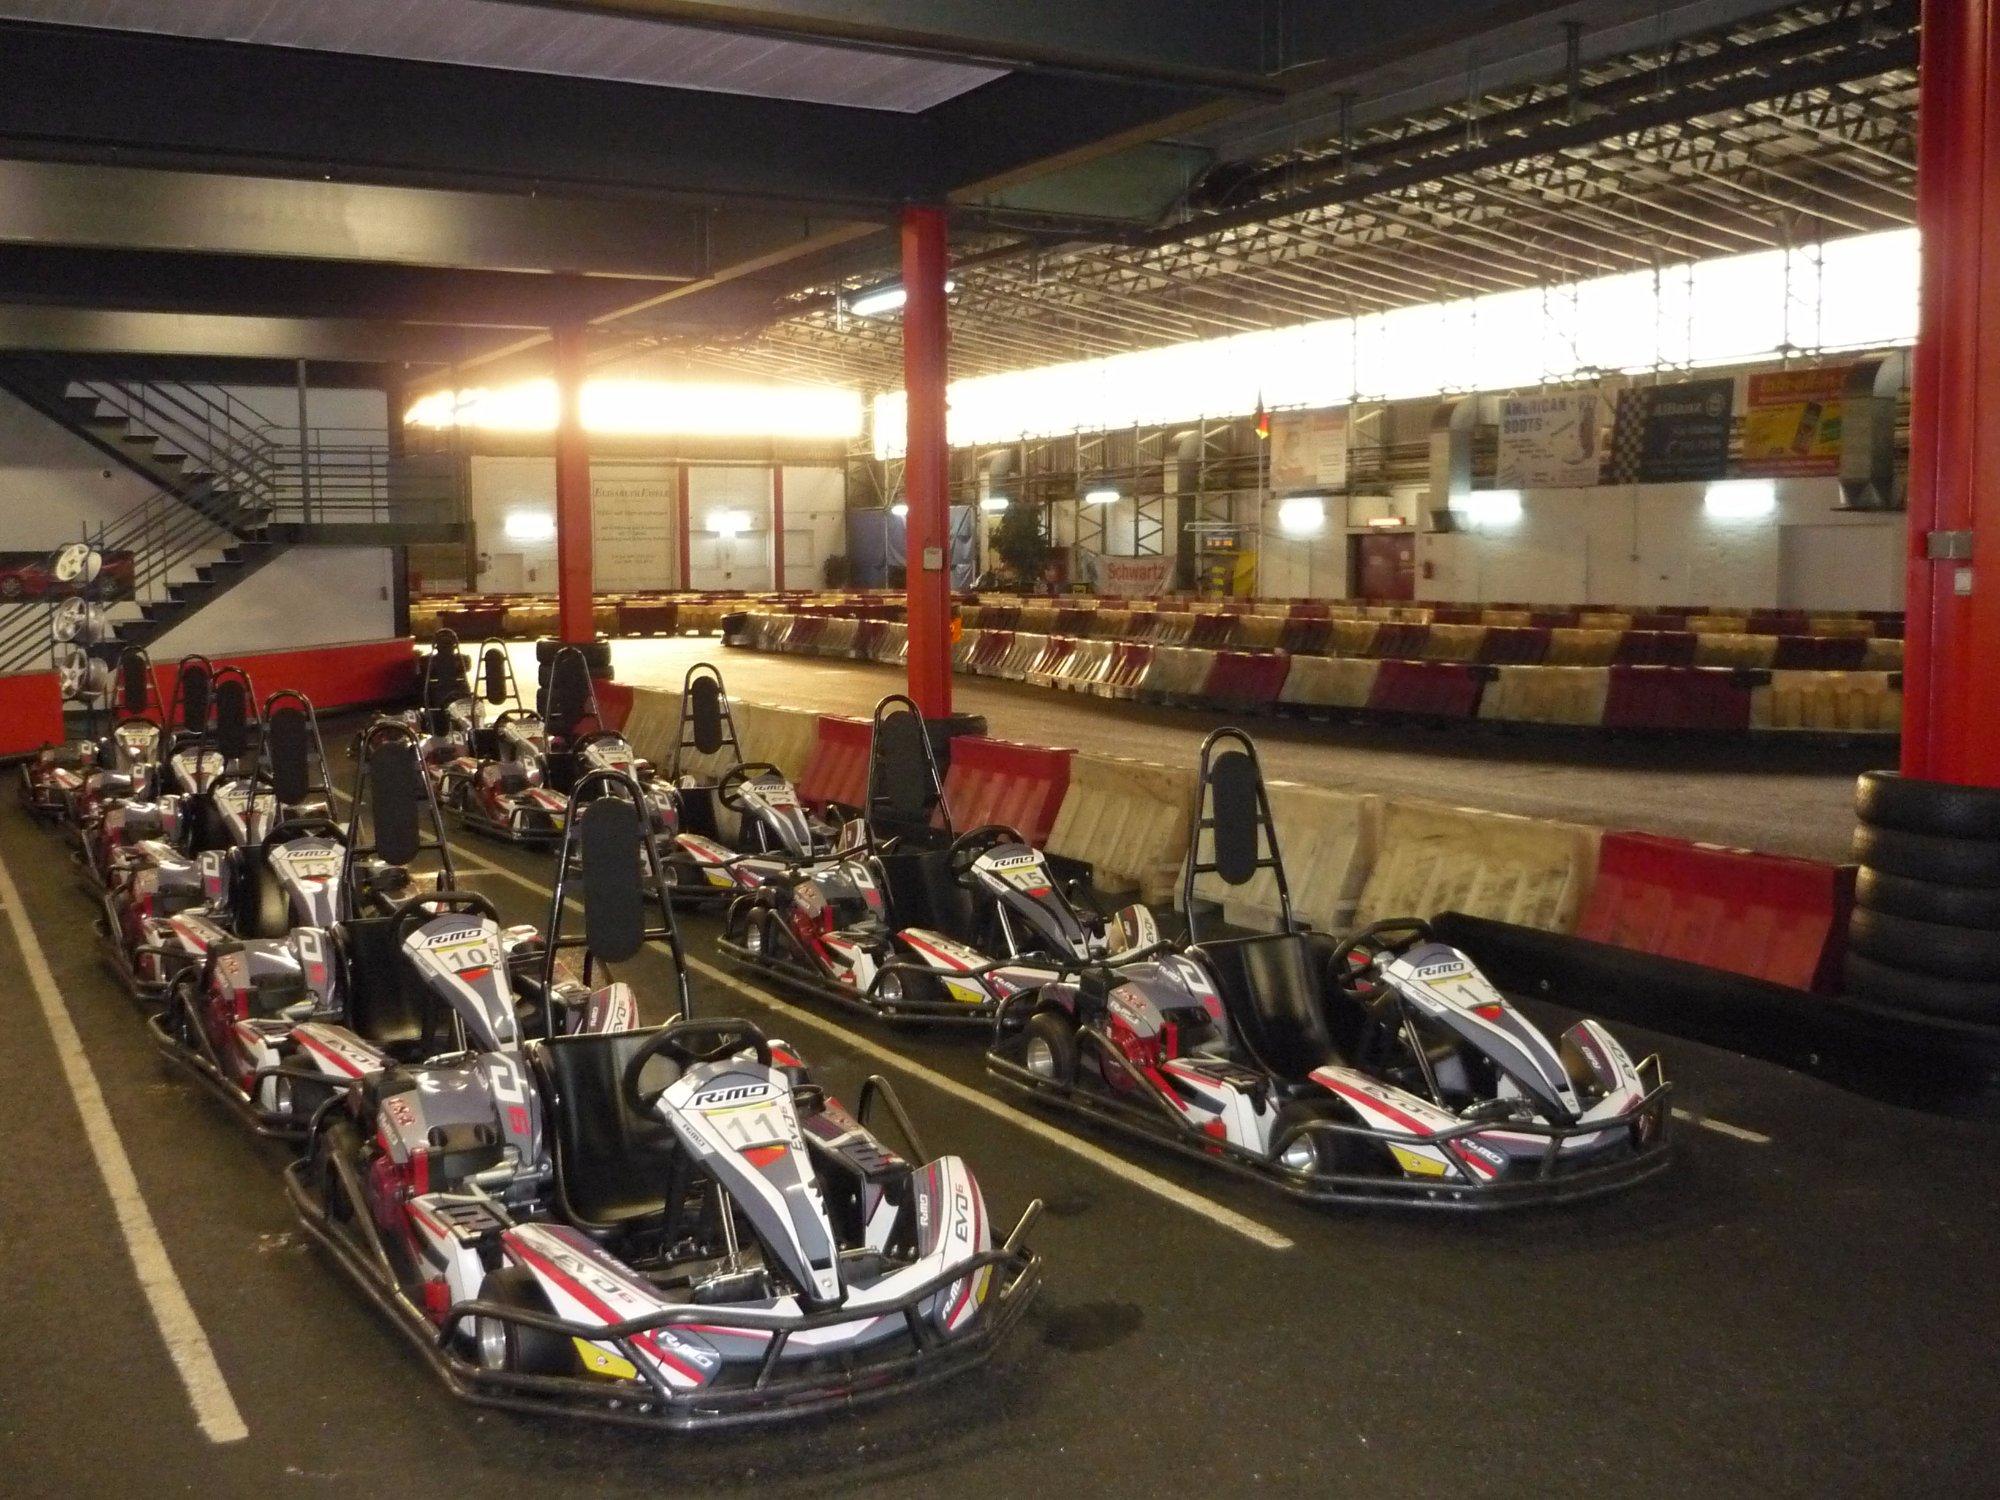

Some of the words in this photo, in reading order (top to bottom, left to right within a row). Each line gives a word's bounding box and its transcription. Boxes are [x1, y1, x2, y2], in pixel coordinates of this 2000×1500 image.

[1013, 871, 1048, 887] 15
[447, 948, 488, 968] 10
[726, 1112, 781, 1144] 11
